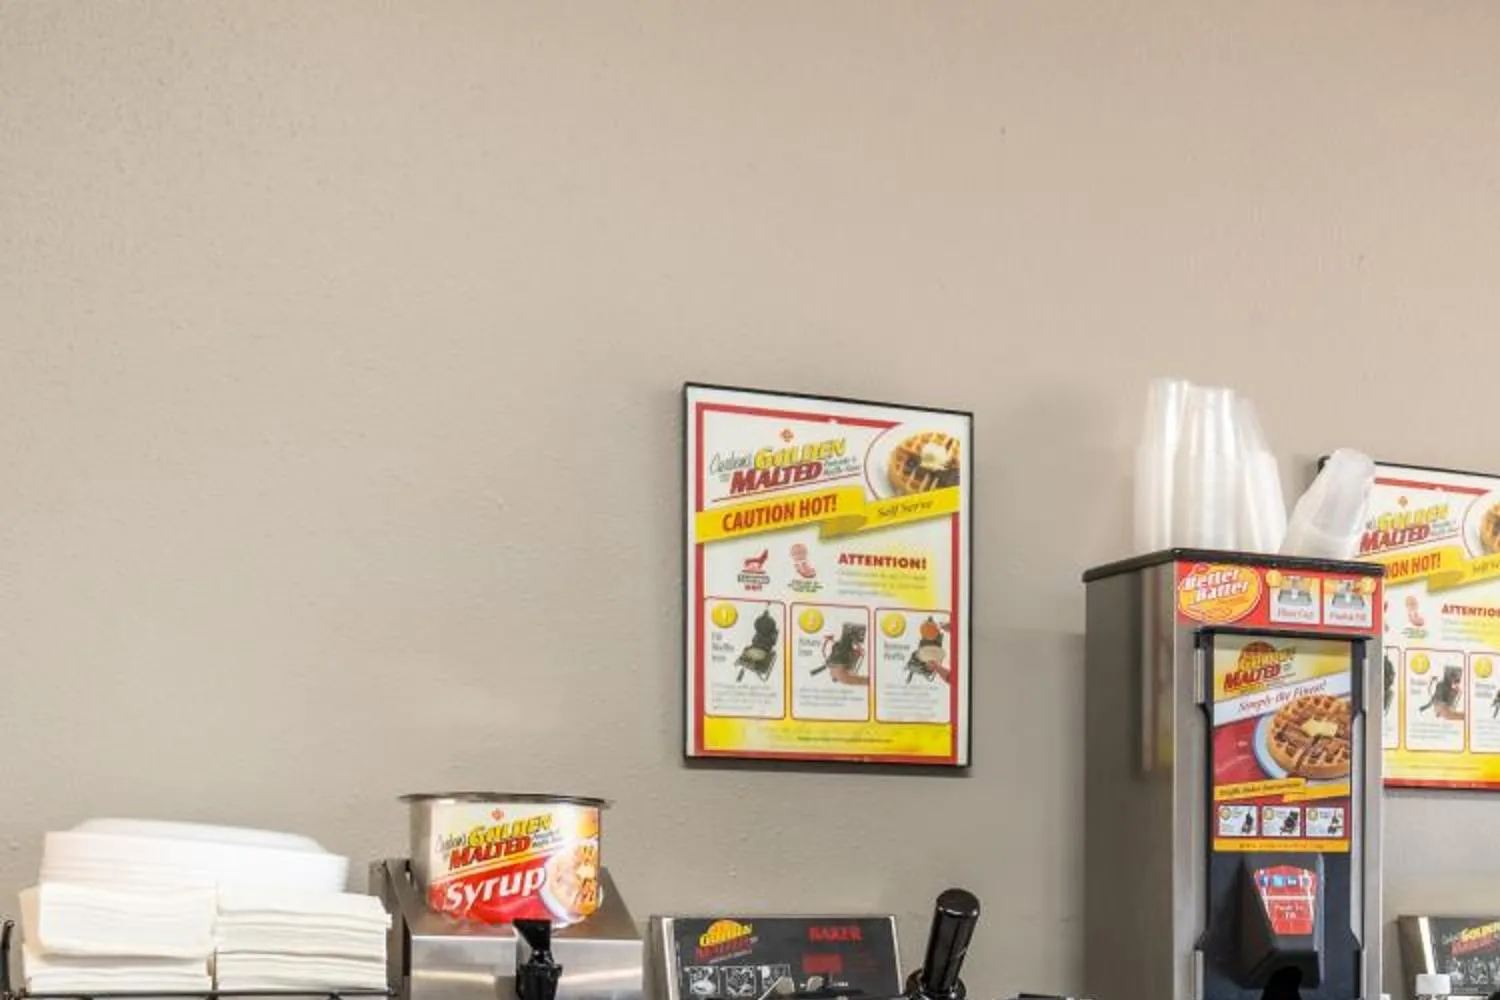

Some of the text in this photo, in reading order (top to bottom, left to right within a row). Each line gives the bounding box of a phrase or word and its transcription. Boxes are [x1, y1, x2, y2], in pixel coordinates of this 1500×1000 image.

[730, 461, 824, 494] MALTED
[722, 494, 839, 532] CAUTION HOT!
[1360, 524, 1430, 551] MALTED
[837, 553, 927, 570] ATTENTION!
[1411, 553, 1441, 573] HOT!
[467, 813, 552, 847] GOLDEN
[449, 836, 531, 870] MALTED
[444, 867, 546, 911] Syrup
[809, 925, 862, 942] BAKER
